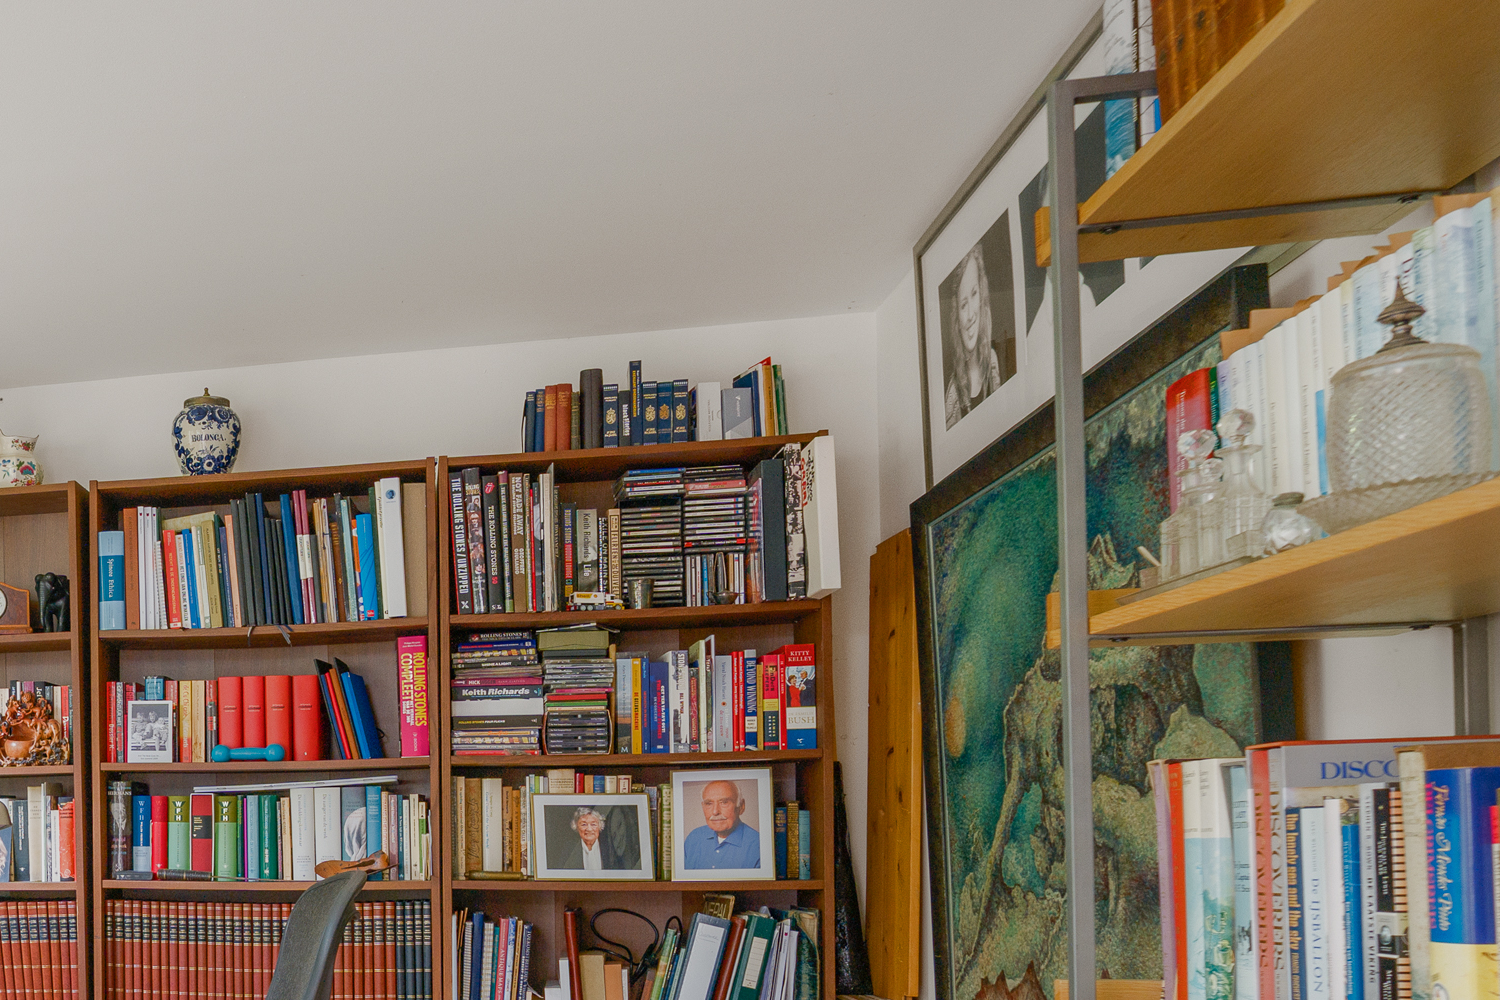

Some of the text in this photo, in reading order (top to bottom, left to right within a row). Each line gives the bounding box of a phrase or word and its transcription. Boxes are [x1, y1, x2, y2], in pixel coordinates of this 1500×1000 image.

[514, 477, 524, 536] NOT FADE AWAY
[451, 478, 469, 594] THE ROLLING STONES UNZIPPED
[489, 520, 497, 548] ROLLING
[583, 513, 592, 578] Keith Richards Life
[490, 550, 498, 576] STONES
[401, 652, 414, 700] COMPLEET
[413, 652, 427, 726] ROLLING STONES
[746, 660, 757, 713] BEYOND WINNING
[462, 688, 530, 696] Keith Richards
[788, 716, 814, 724] BUSH
[1287, 814, 1300, 830] the
[1286, 832, 1301, 865] lonely
[1434, 832, 1453, 890] Mendes
[1270, 790, 1285, 971] DISCOVERERS
[1288, 866, 1298, 886] sea
[1367, 877, 1374, 890] DE
[703, 902, 728, 920] NEPAL
[1288, 887, 1301, 908] and
[1438, 893, 1454, 931] Pinto
[1288, 911, 1301, 928] the
[1368, 894, 1376, 940] LAATSTE
[1287, 930, 1302, 950] sky
[1310, 878, 1324, 993] De IJSBALLON
[1291, 953, 1300, 974] FRANCIS
